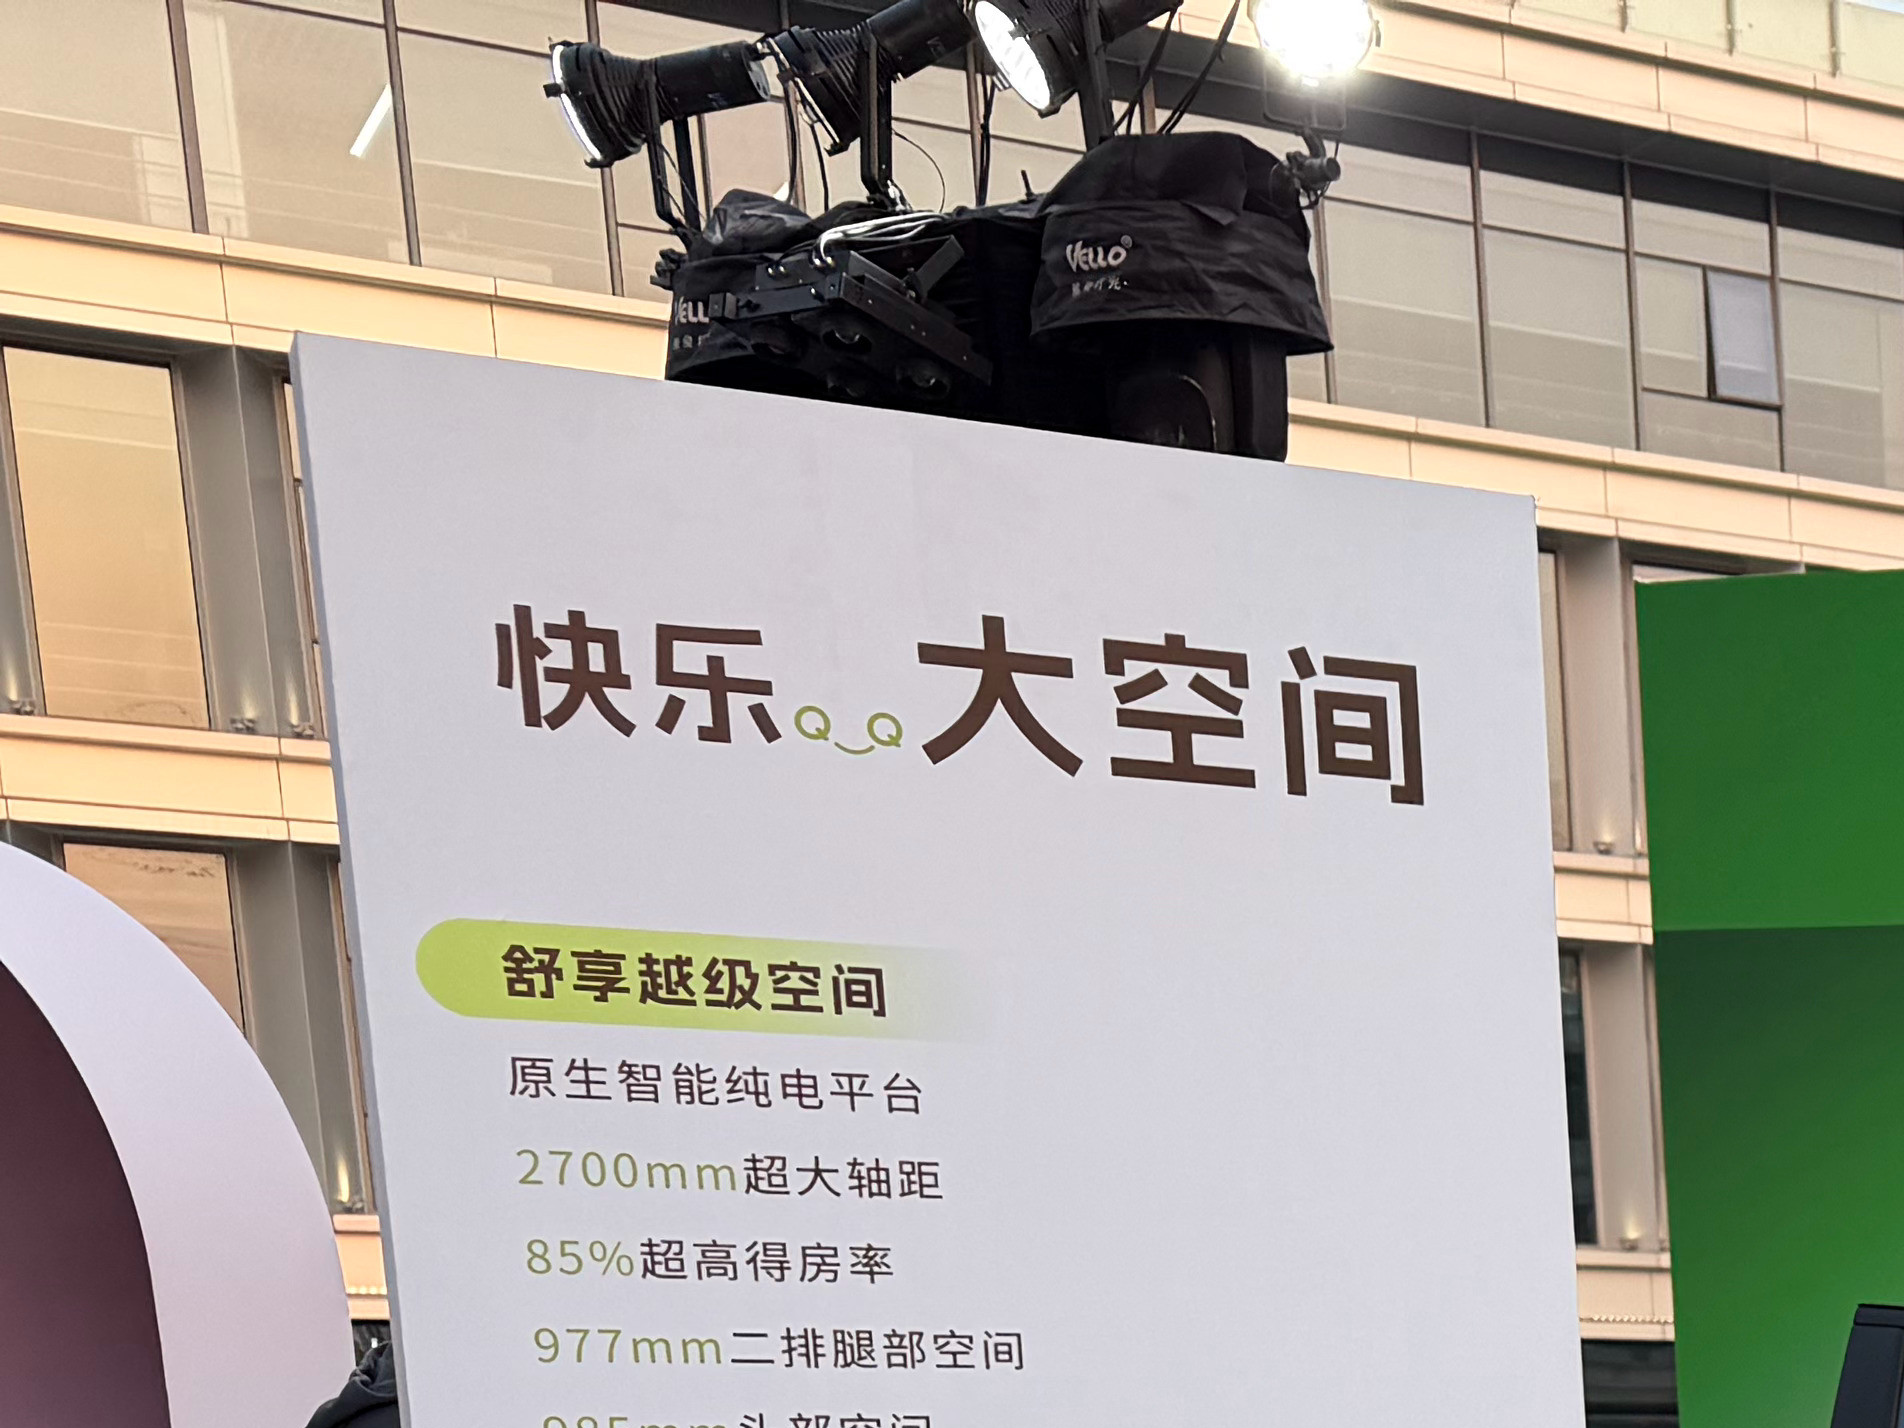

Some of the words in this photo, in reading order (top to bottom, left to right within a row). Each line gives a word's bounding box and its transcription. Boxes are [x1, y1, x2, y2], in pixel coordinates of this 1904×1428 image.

[500, 943, 887, 1018] 舒享越级空间
[508, 1056, 922, 1115] 原生智能纯电平台
[515, 1149, 944, 1200] 2700mm超大轴距
[525, 1237, 894, 1285] 85%超高得房率
[533, 1326, 1025, 1371] 977mm二排腿部空间
